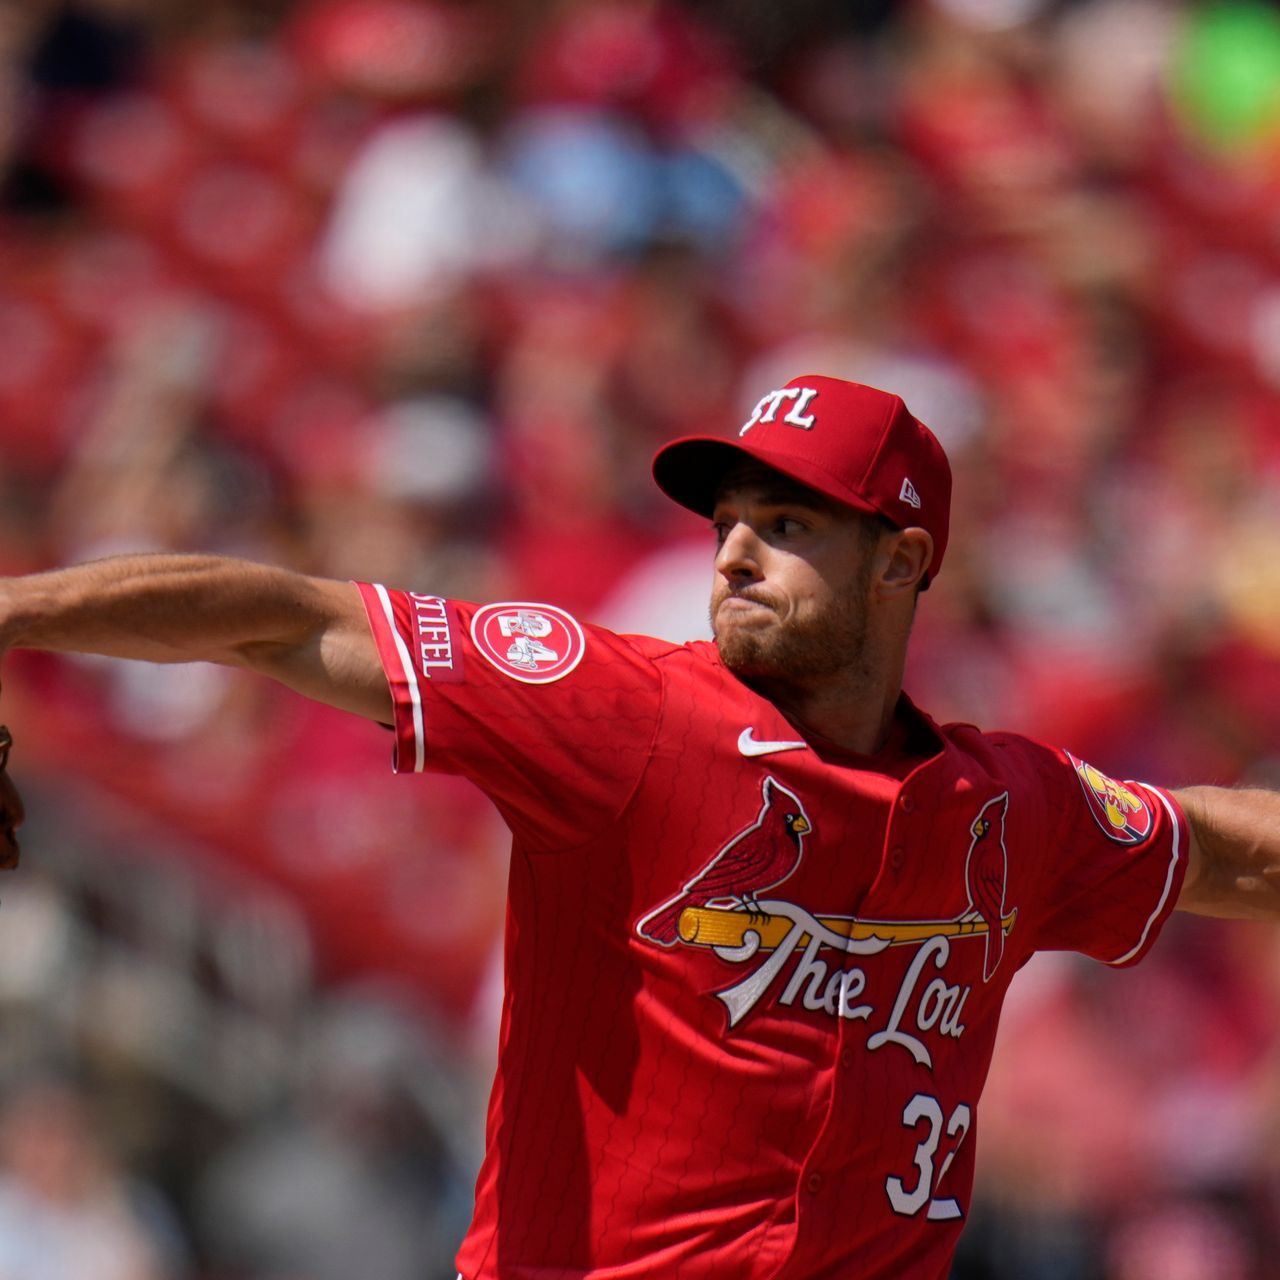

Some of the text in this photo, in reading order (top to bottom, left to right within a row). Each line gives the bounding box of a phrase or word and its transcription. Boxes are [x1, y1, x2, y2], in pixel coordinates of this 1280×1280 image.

[410, 592, 454, 678] STIFEL
[867, 933, 971, 1068] Lou
[884, 1094, 971, 1221] 32
